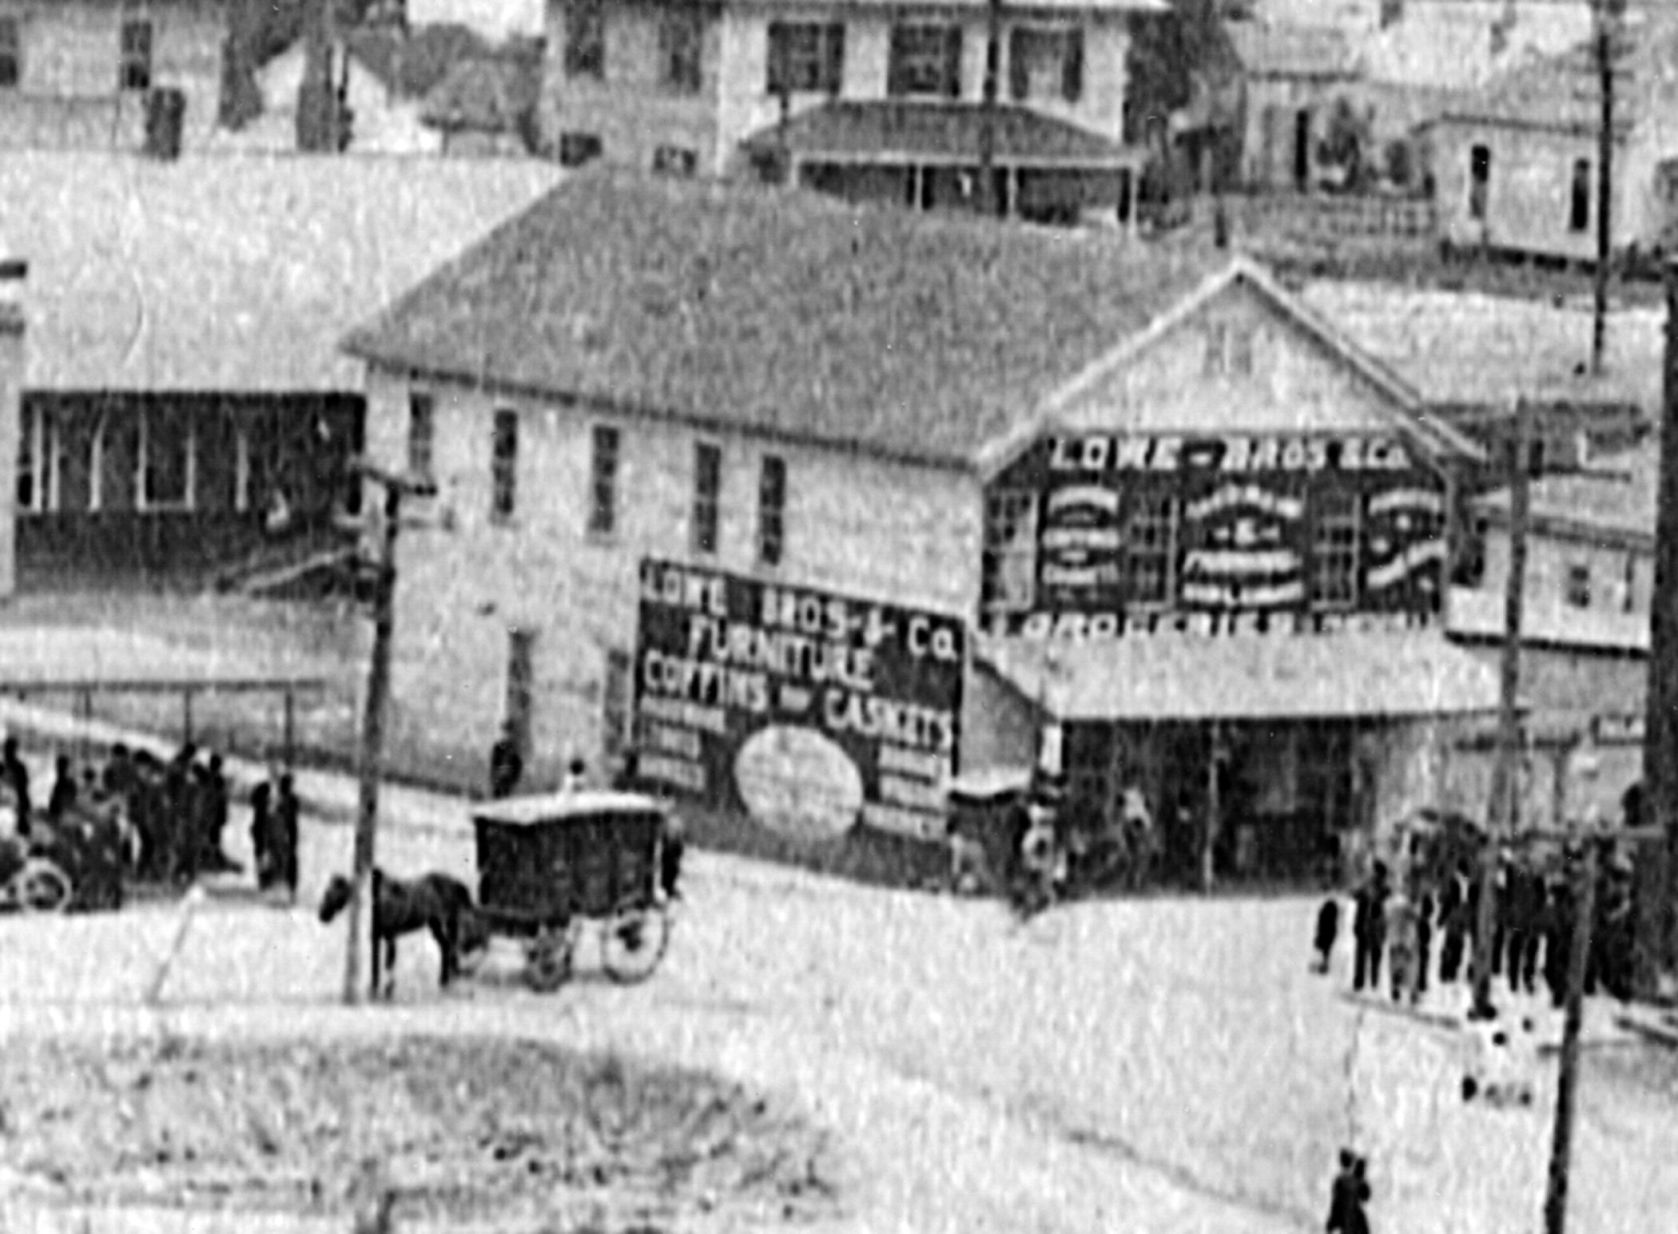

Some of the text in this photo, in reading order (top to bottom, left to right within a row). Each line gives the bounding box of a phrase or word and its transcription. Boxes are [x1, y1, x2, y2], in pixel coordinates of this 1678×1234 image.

[689, 614, 874, 691] FURNITURE
[644, 649, 765, 712] COFFINS
[824, 687, 952, 748] CASKETS
